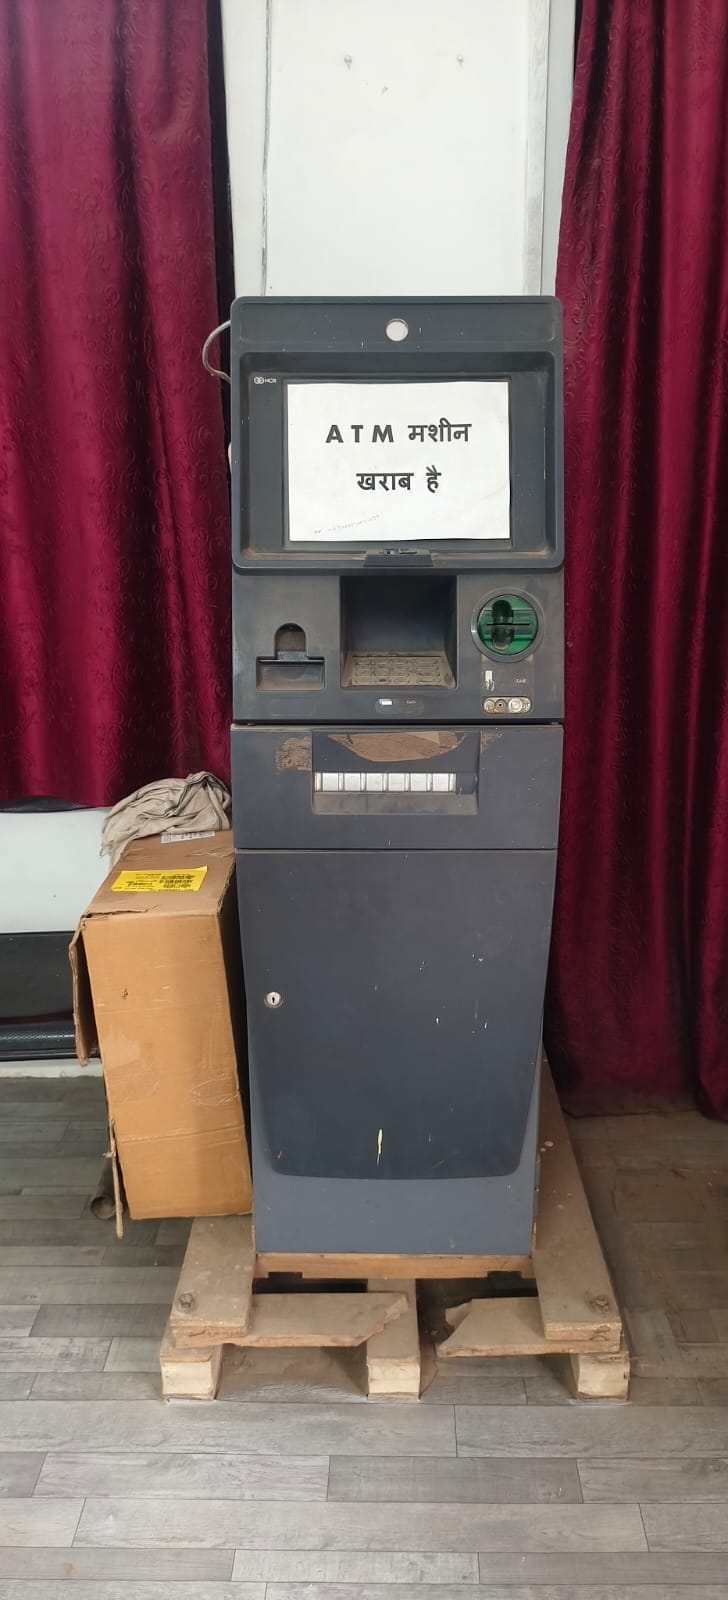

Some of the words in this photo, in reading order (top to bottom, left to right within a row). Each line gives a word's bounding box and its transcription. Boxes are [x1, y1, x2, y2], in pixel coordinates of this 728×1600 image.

[407, 417, 473, 442] मशीन
[355, 472, 415, 491] खराब
[425, 465, 442, 494] है
